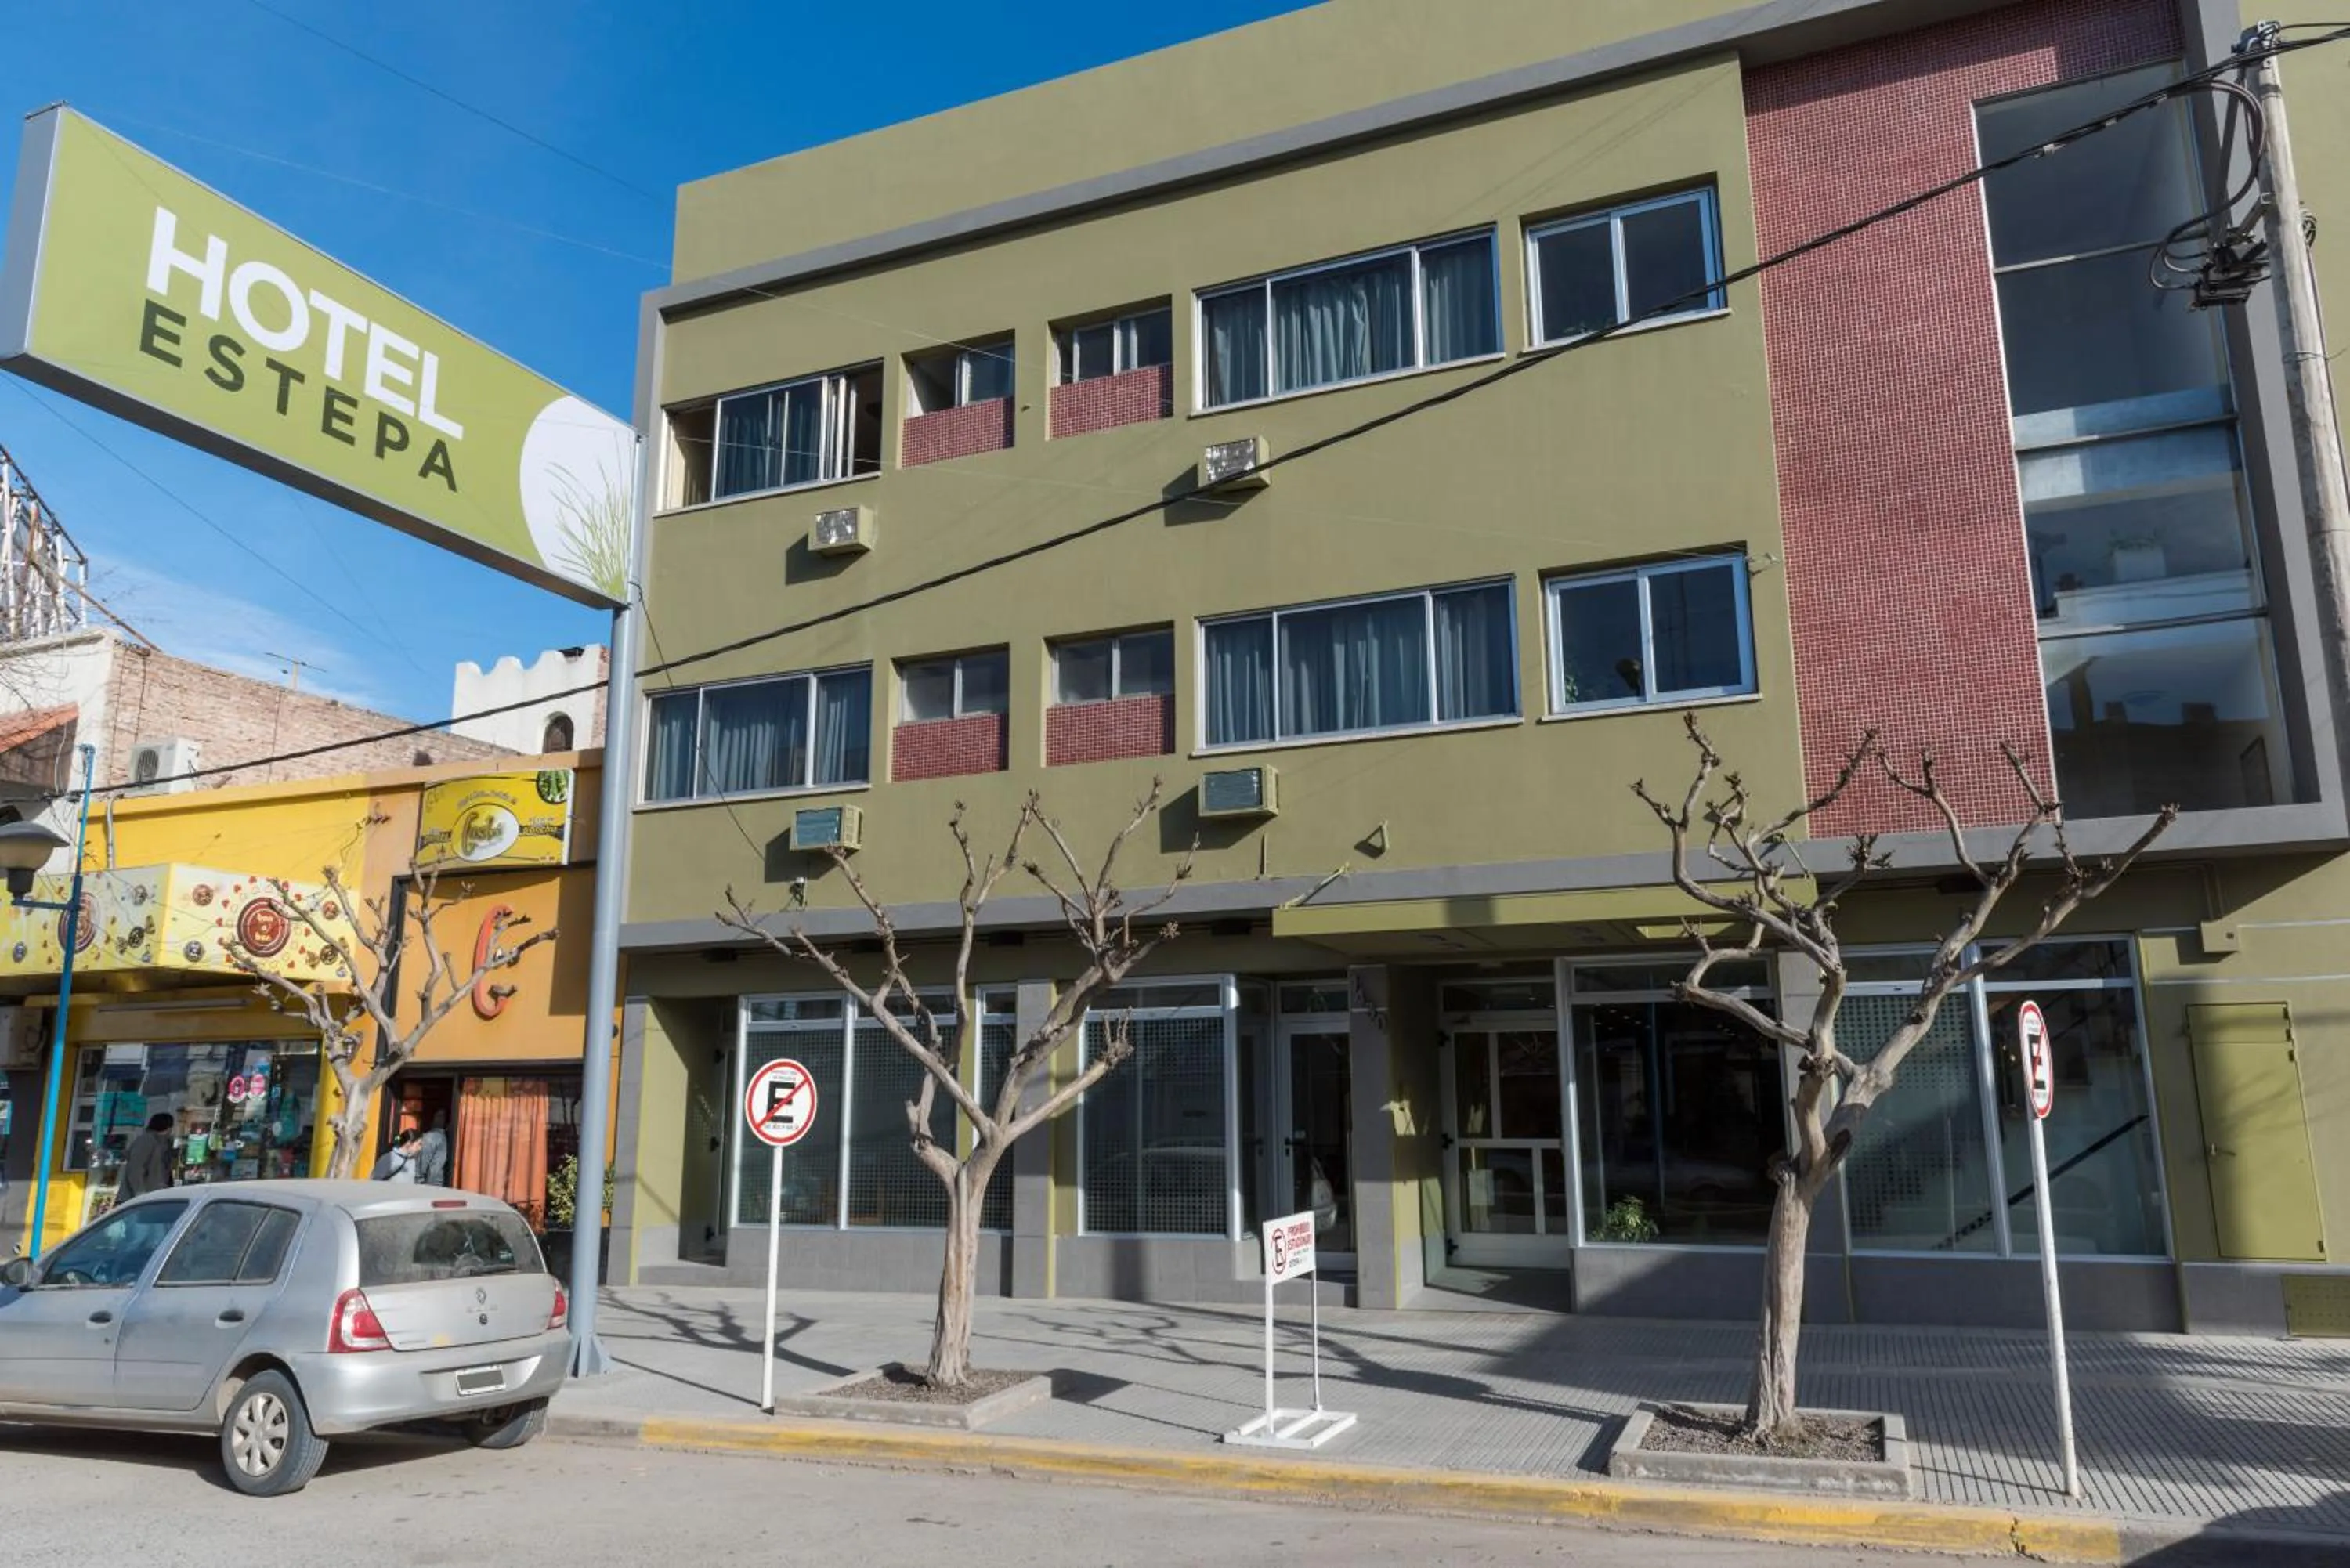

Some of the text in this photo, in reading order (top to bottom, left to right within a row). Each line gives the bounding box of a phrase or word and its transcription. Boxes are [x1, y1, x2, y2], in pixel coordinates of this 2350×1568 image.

[139, 298, 459, 493] ESTEPA
[146, 205, 464, 440] HOTEL
[766, 1080, 796, 1123] E
